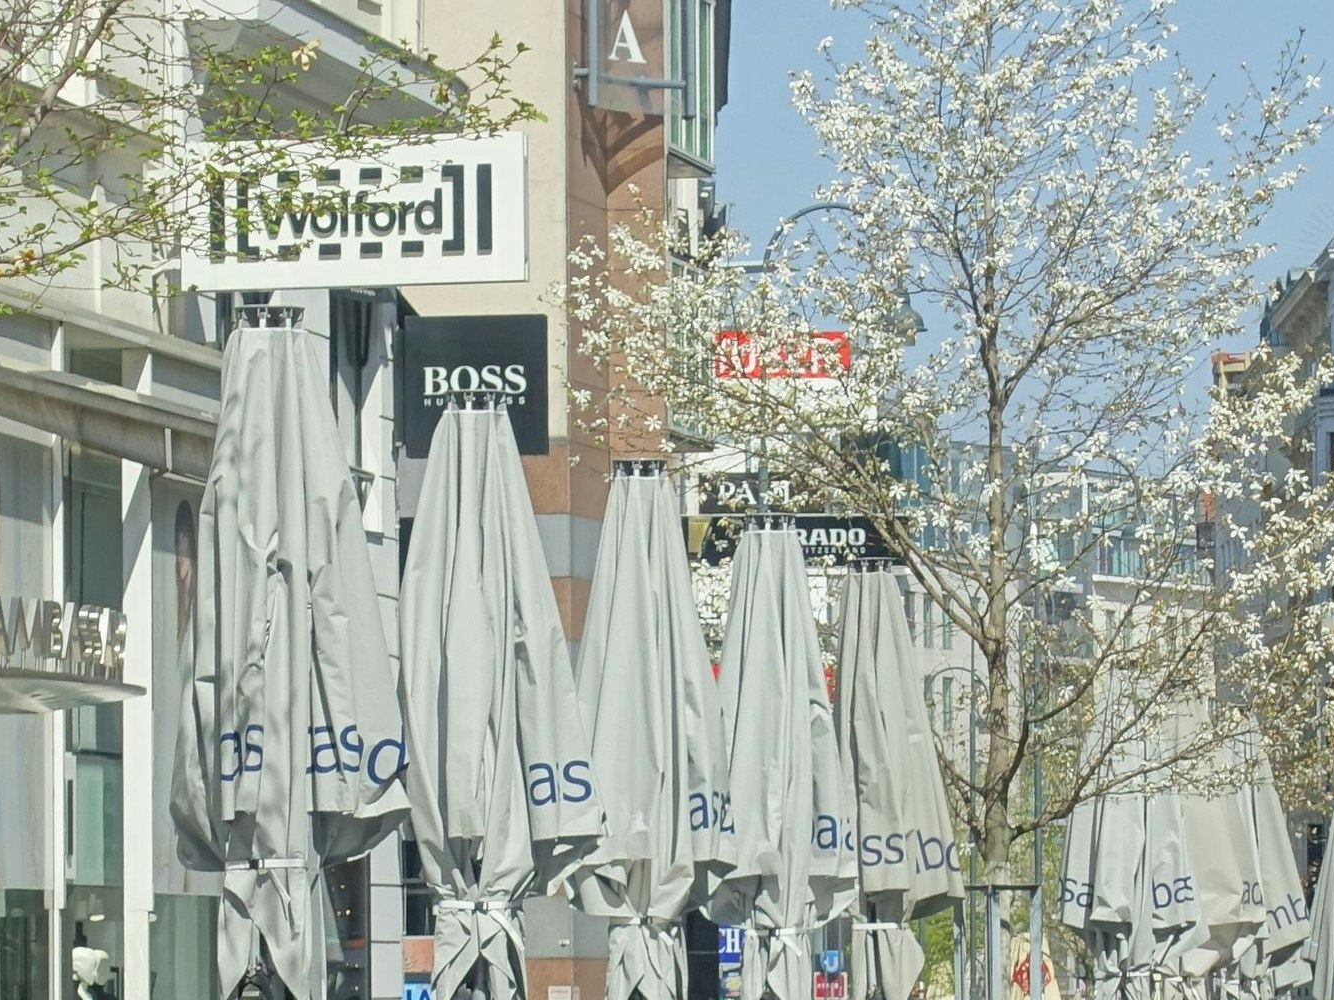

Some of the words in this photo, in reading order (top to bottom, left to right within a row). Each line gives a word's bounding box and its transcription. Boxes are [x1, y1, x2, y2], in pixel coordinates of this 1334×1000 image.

[263, 187, 442, 240] Wolford
[422, 365, 527, 396] BOSS
[797, 527, 867, 546] RADO
